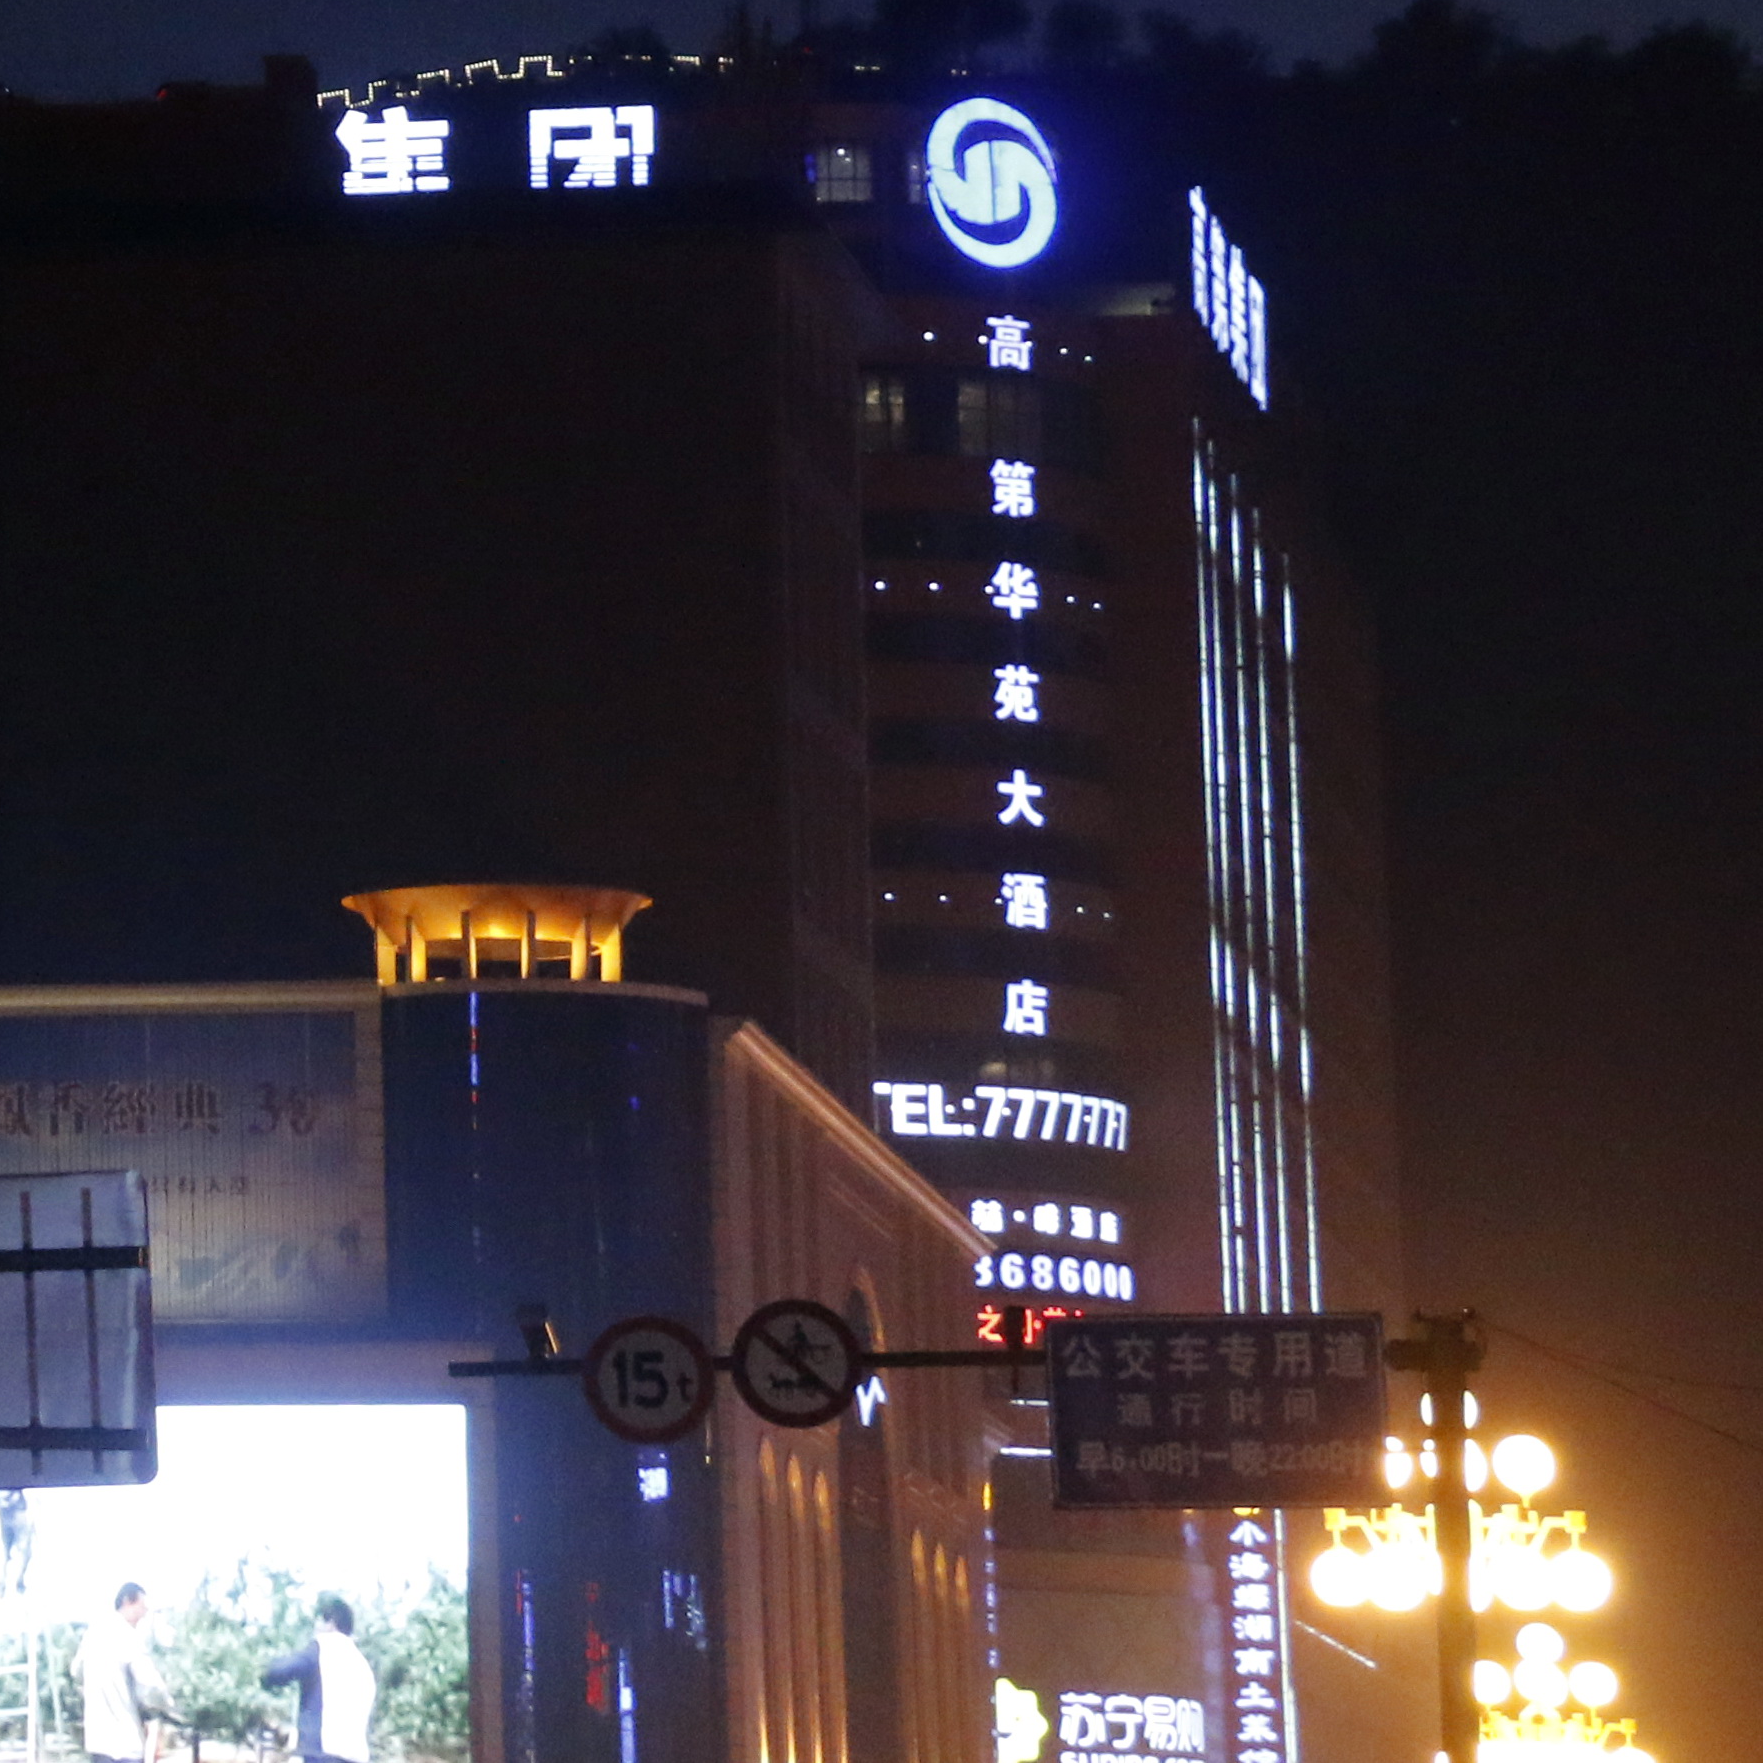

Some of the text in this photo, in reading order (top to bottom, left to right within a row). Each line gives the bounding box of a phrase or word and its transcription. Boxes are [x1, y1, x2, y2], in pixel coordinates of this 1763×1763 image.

[985, 314, 1050, 1036] 高第华苑大酒店
[1061, 1329, 1367, 1380] 公交车专用道
[1116, 1385, 1319, 1427] 通行时间
[1058, 1692, 1206, 1753] 苏宁易购
